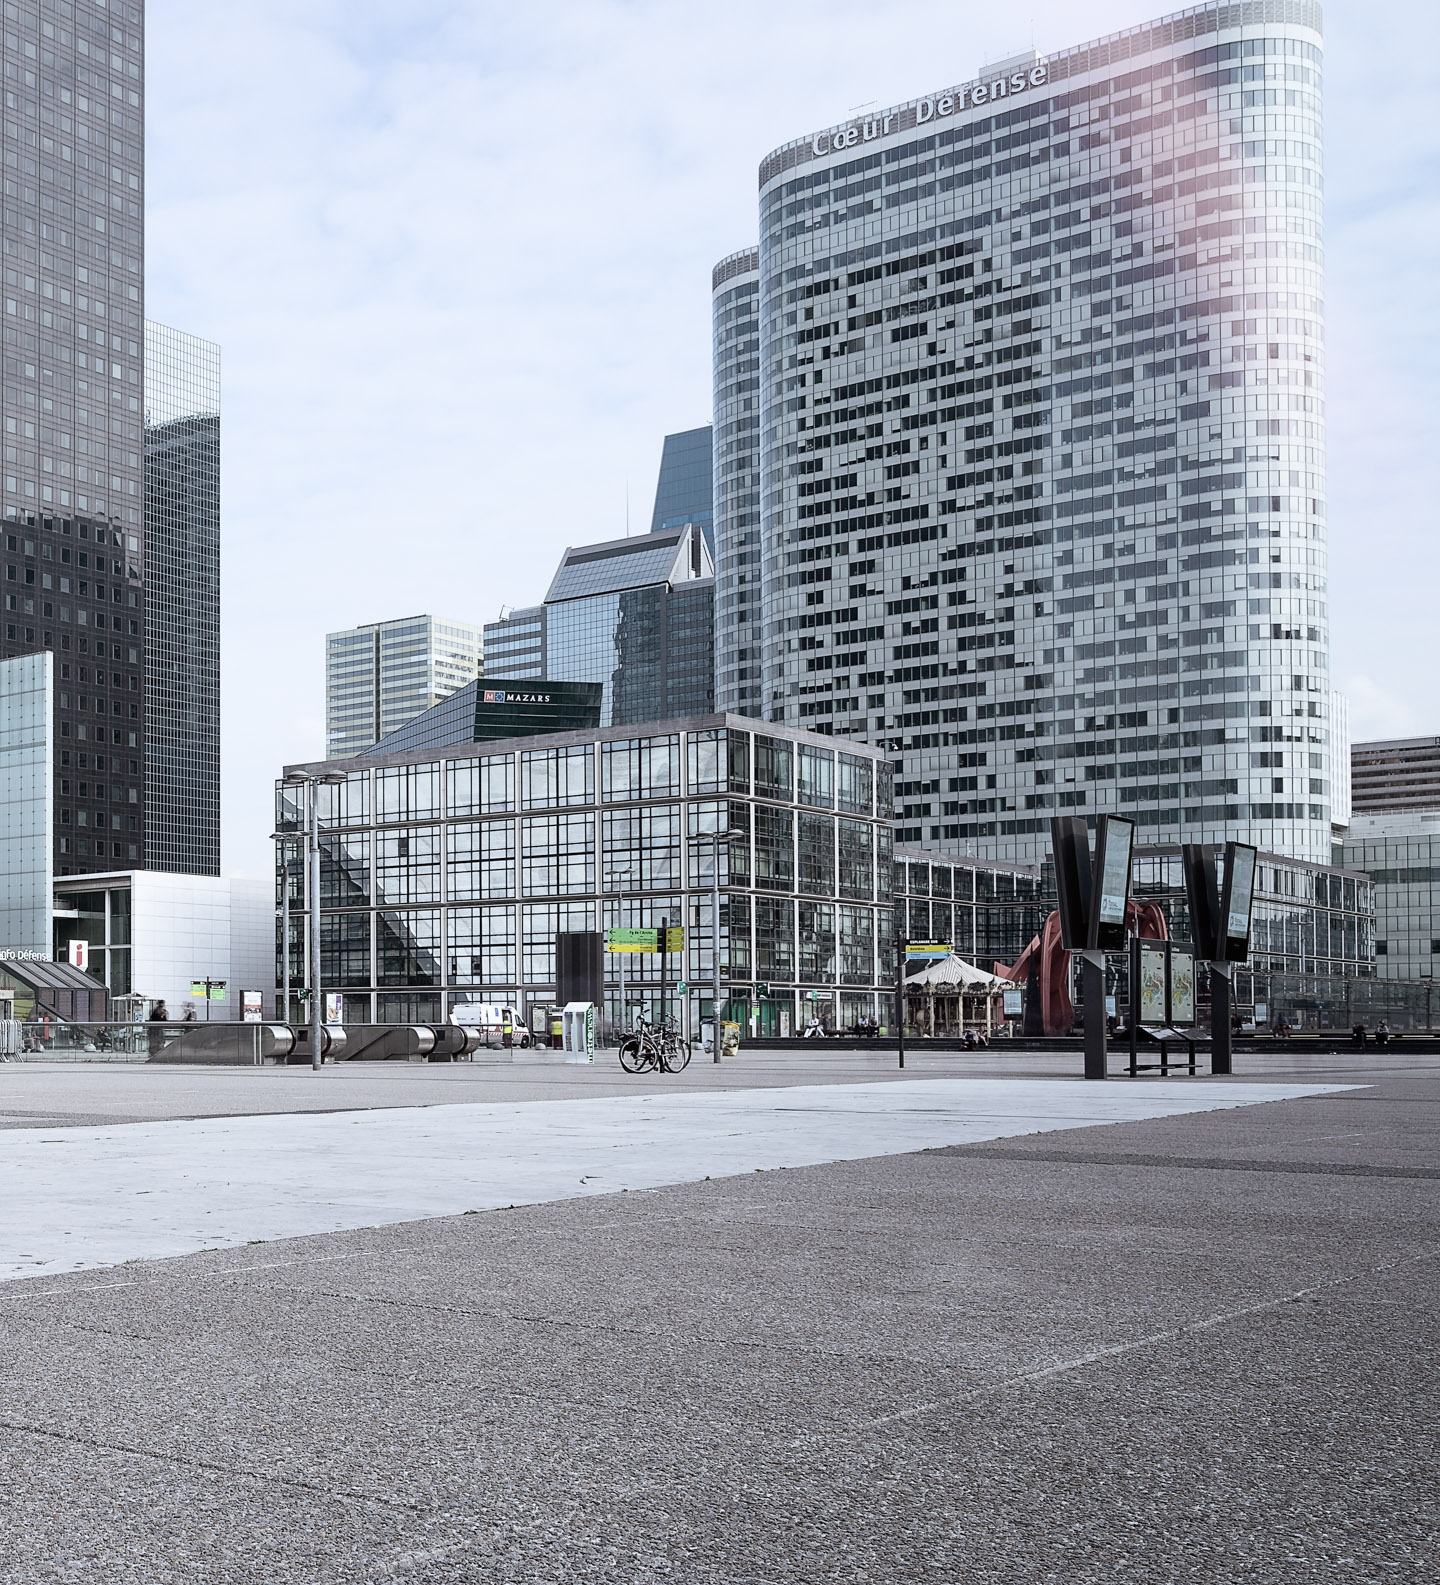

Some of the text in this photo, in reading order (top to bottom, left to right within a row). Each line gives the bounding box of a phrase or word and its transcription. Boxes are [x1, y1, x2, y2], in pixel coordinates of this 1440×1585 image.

[812, 64, 1048, 156] Cœur Défense
[506, 693, 551, 703] MAZARS
[17, 949, 51, 961] Défense
